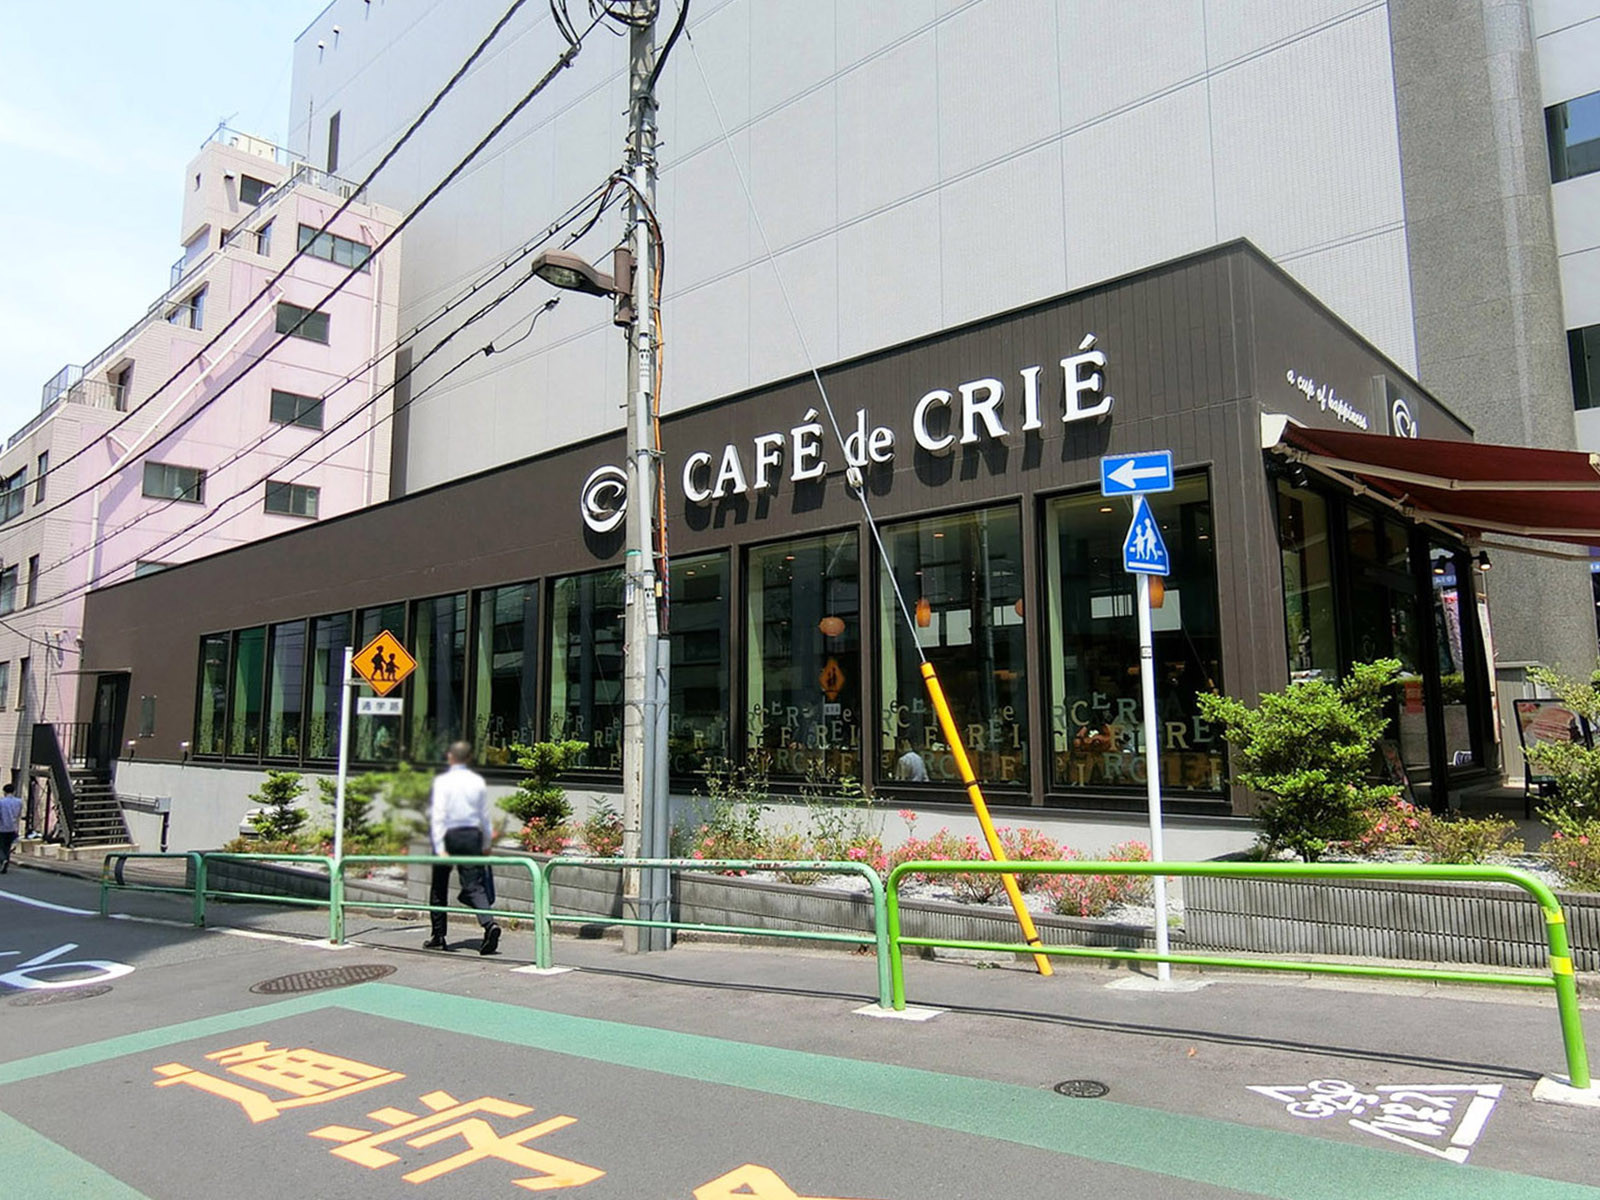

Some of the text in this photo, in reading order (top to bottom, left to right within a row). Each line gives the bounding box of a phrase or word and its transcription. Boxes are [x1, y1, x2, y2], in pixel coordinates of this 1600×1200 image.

[682, 332, 1114, 503] CAFÉ de CRIÉ
[1328, 388, 1368, 430] happiness
